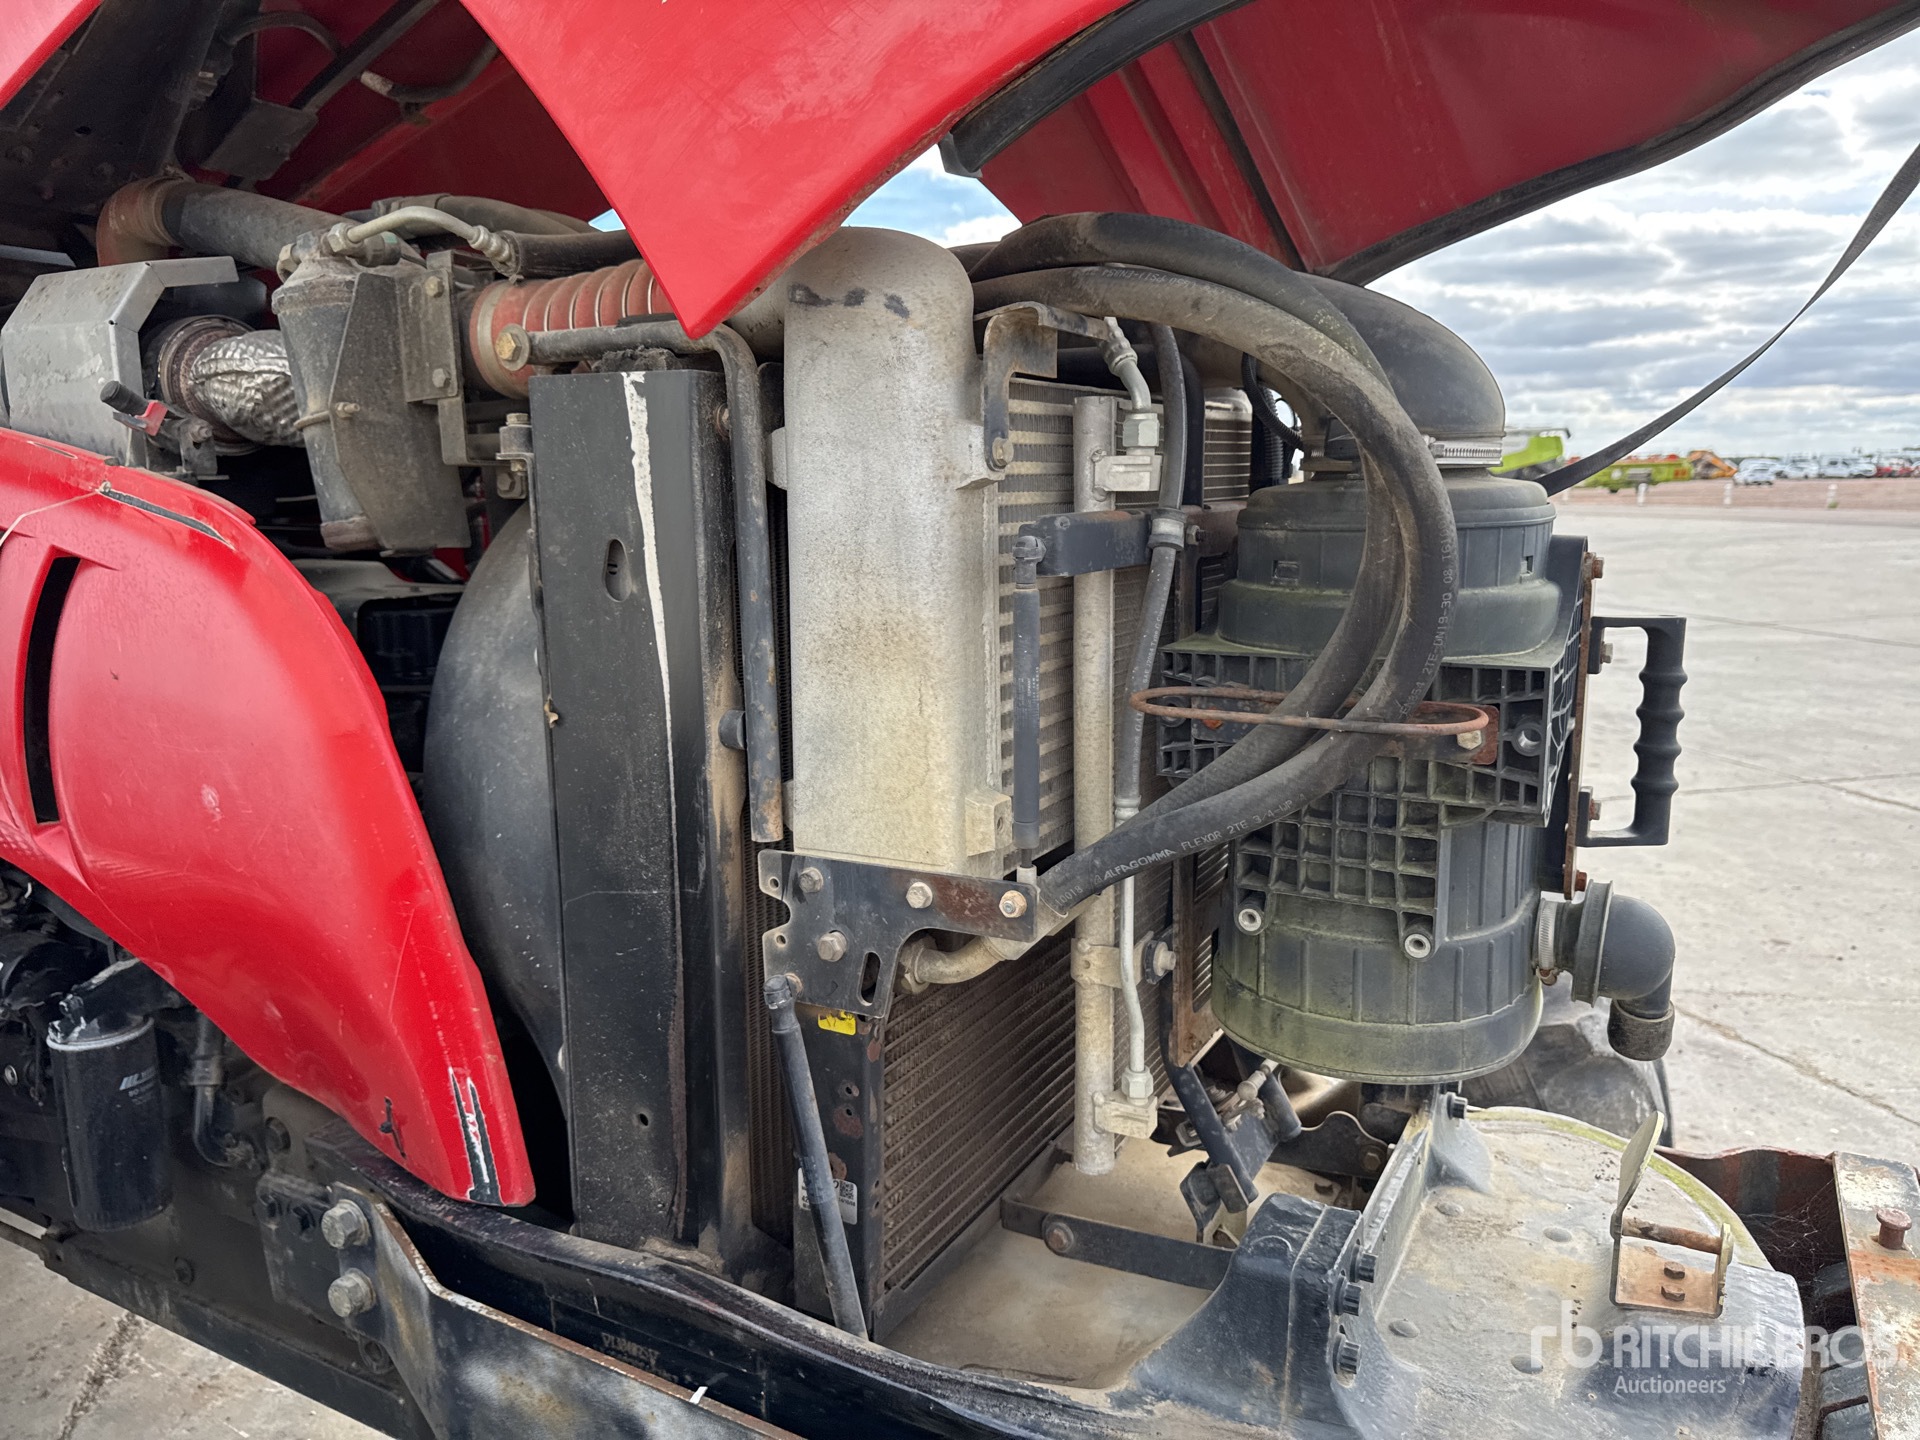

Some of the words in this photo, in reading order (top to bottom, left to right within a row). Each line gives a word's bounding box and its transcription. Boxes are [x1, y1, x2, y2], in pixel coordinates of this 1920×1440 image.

[1103, 848, 1177, 880] ALFAGOMMA
[1180, 831, 1222, 851] FLEXOR
[1226, 819, 1248, 835] 2TE
